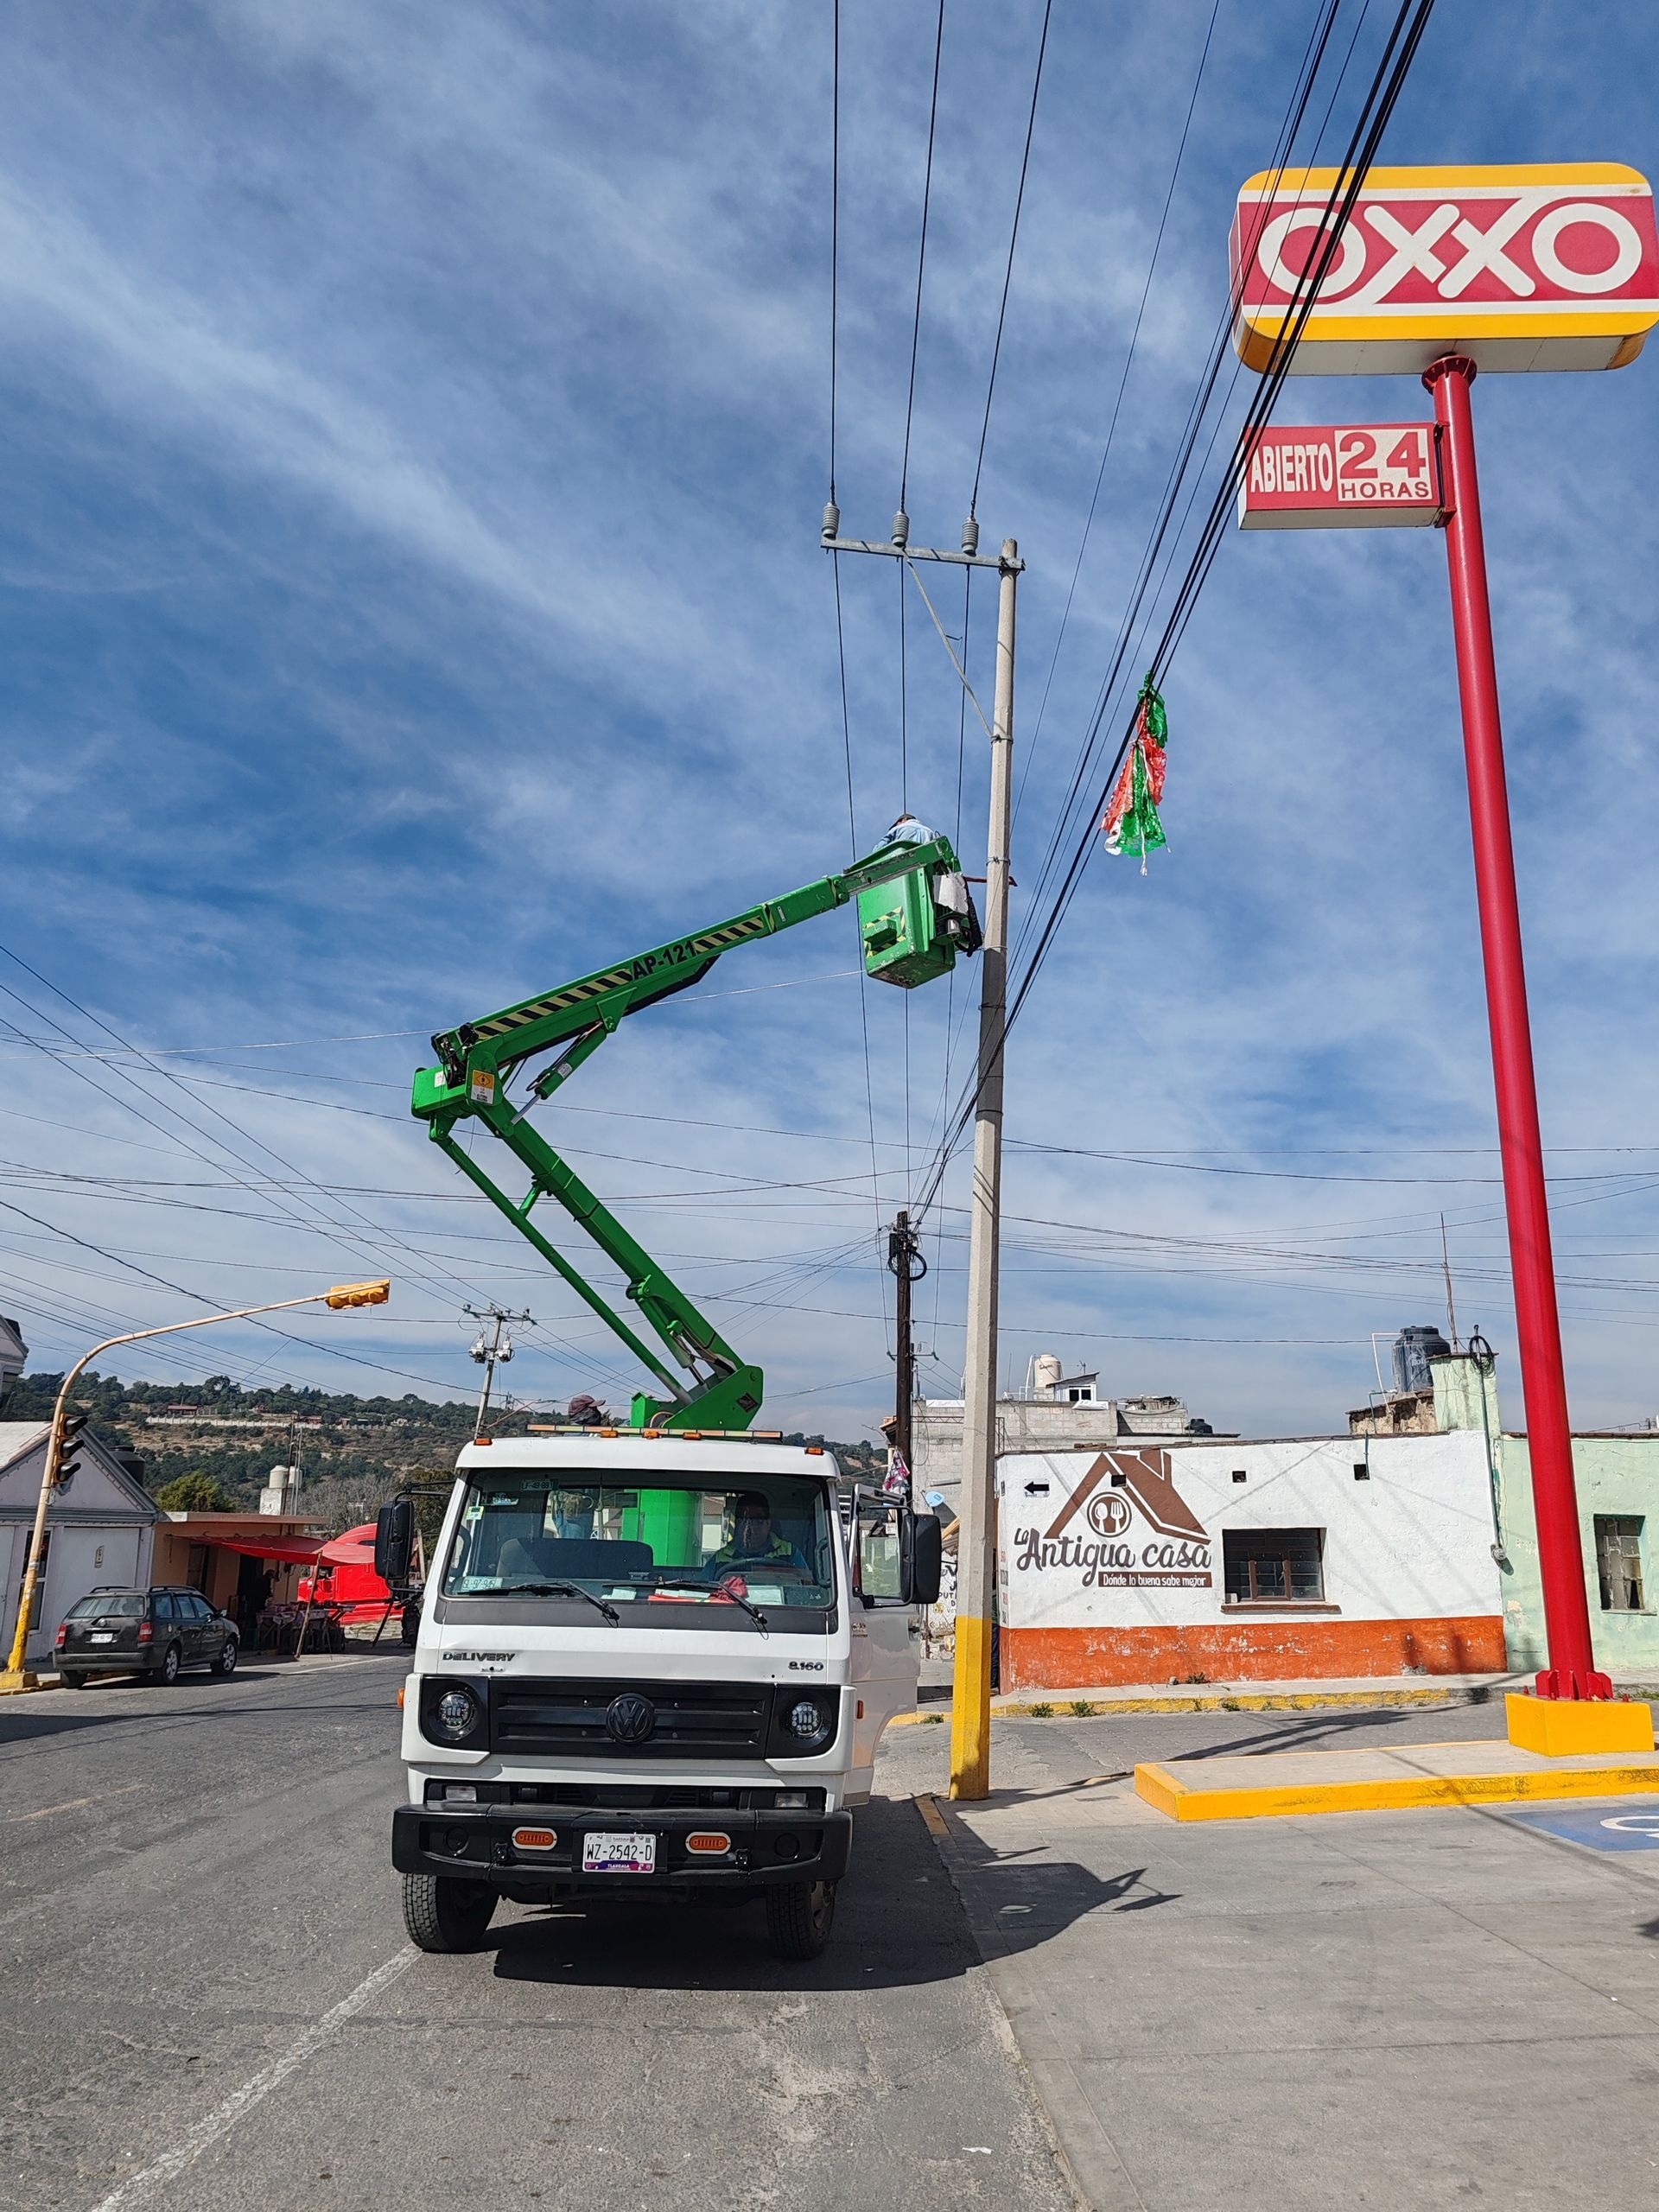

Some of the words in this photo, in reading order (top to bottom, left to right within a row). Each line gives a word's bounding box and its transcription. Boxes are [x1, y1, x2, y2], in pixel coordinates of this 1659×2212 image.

[1258, 198, 1643, 303] OXXO
[1250, 442, 1333, 493] ABIERTO
[1339, 431, 1427, 480] 24
[1341, 481, 1430, 499] HORAS
[632, 939, 696, 980] AP-121
[1014, 1528, 1030, 1546] La
[1016, 1528, 1135, 1587] Antigua
[1141, 1541, 1212, 1569] casa
[1103, 1573, 1127, 1586] Dónde
[1128, 1573, 1136, 1586] lo
[1161, 1574, 1181, 1586] sabe
[1181, 1574, 1207, 1587] mejor
[442, 1651, 516, 1662] DELIVERY
[787, 1660, 824, 1671] 8.160
[587, 1843, 652, 1861] WZ-2542-D
